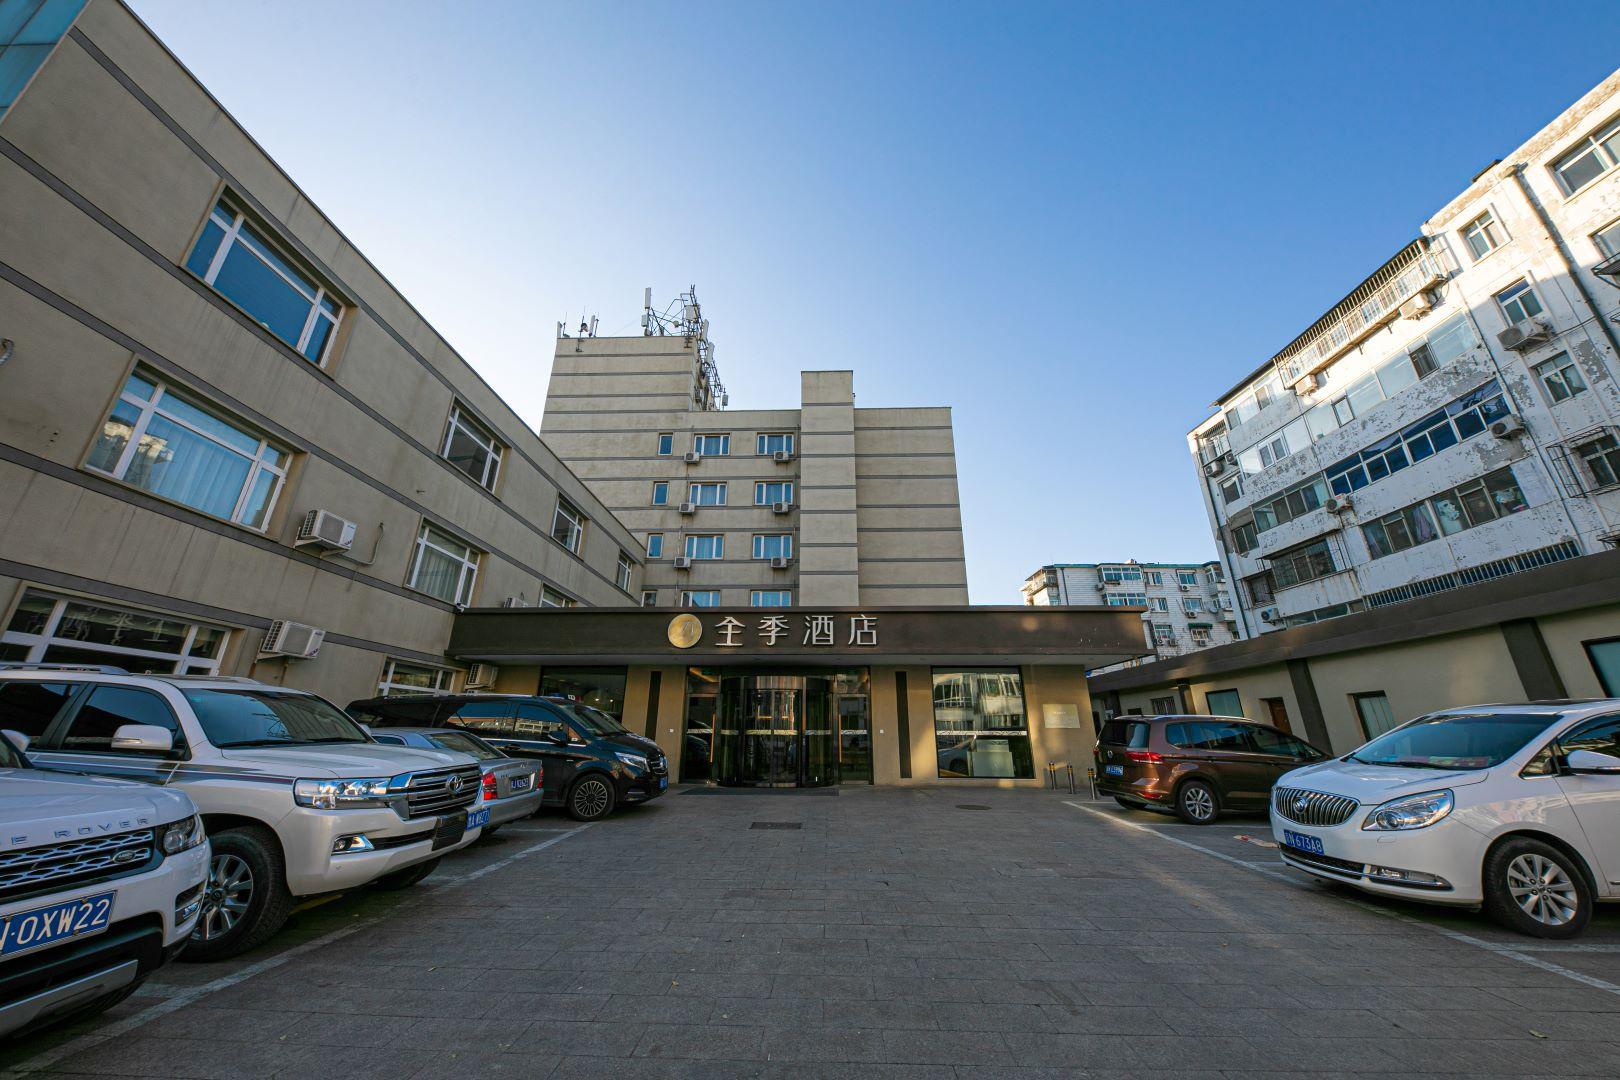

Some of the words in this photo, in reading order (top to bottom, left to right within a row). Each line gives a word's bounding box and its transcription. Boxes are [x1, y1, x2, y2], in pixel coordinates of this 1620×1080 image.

[715, 614, 878, 647] 全季酒店
[53, 817, 149, 839] ROVER
